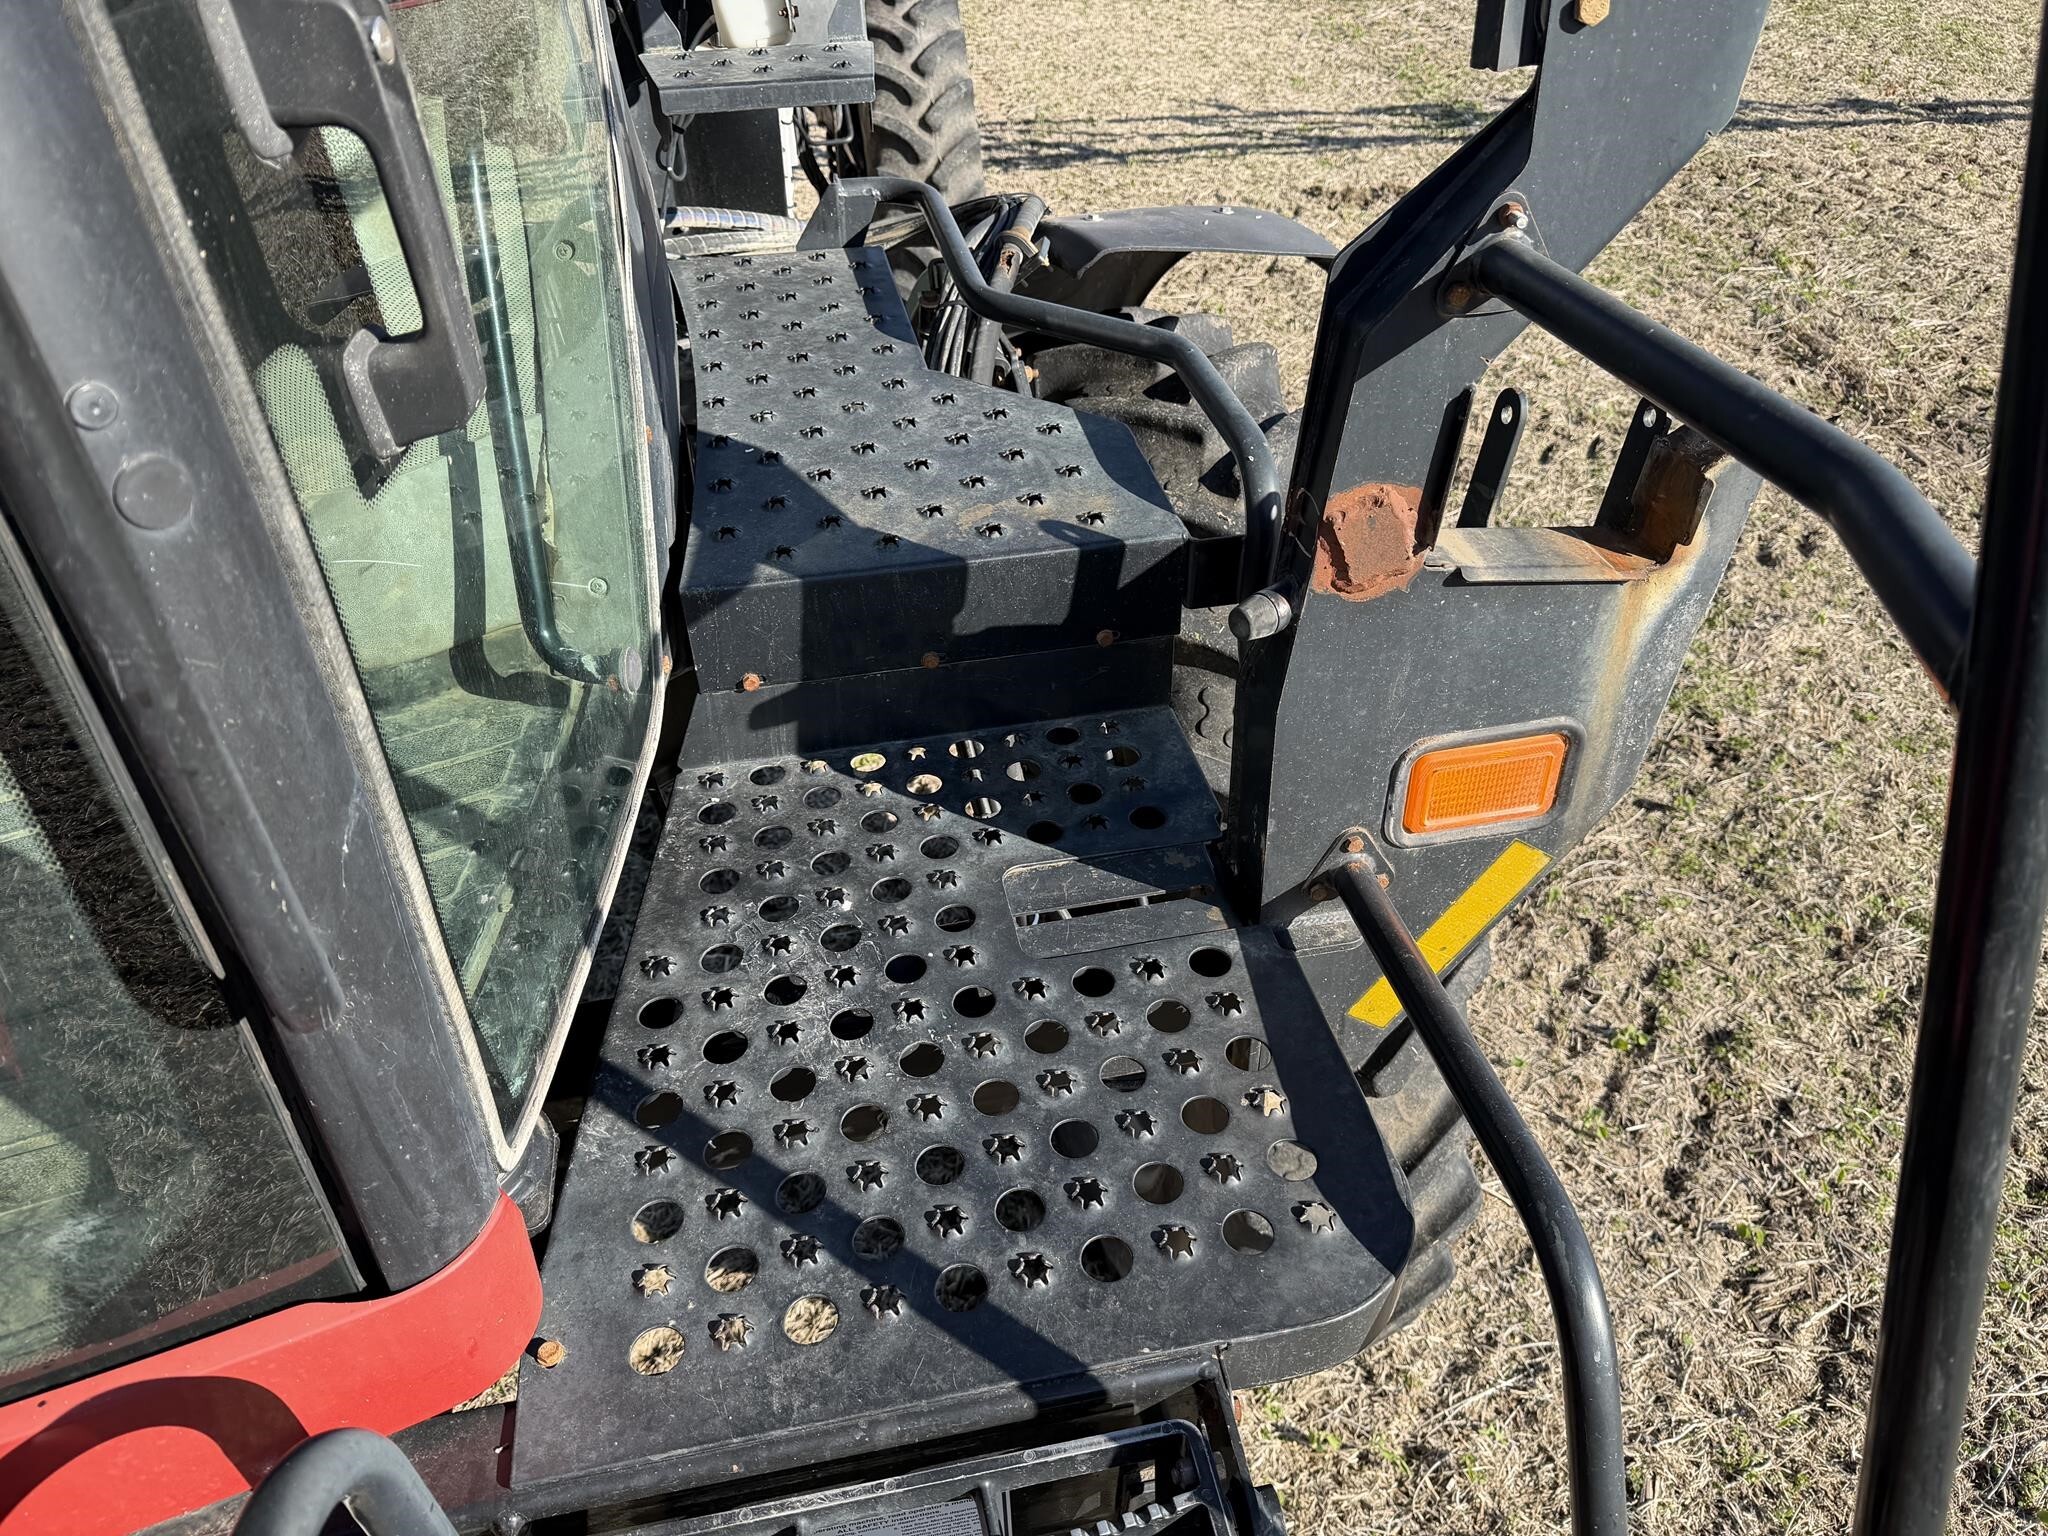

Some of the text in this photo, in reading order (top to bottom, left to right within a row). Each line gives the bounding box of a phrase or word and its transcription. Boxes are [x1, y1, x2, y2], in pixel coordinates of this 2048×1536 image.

[908, 1504, 949, 1514] operator's
[855, 1521, 889, 1530] SAFETY
[891, 1510, 941, 1522] instructions.
